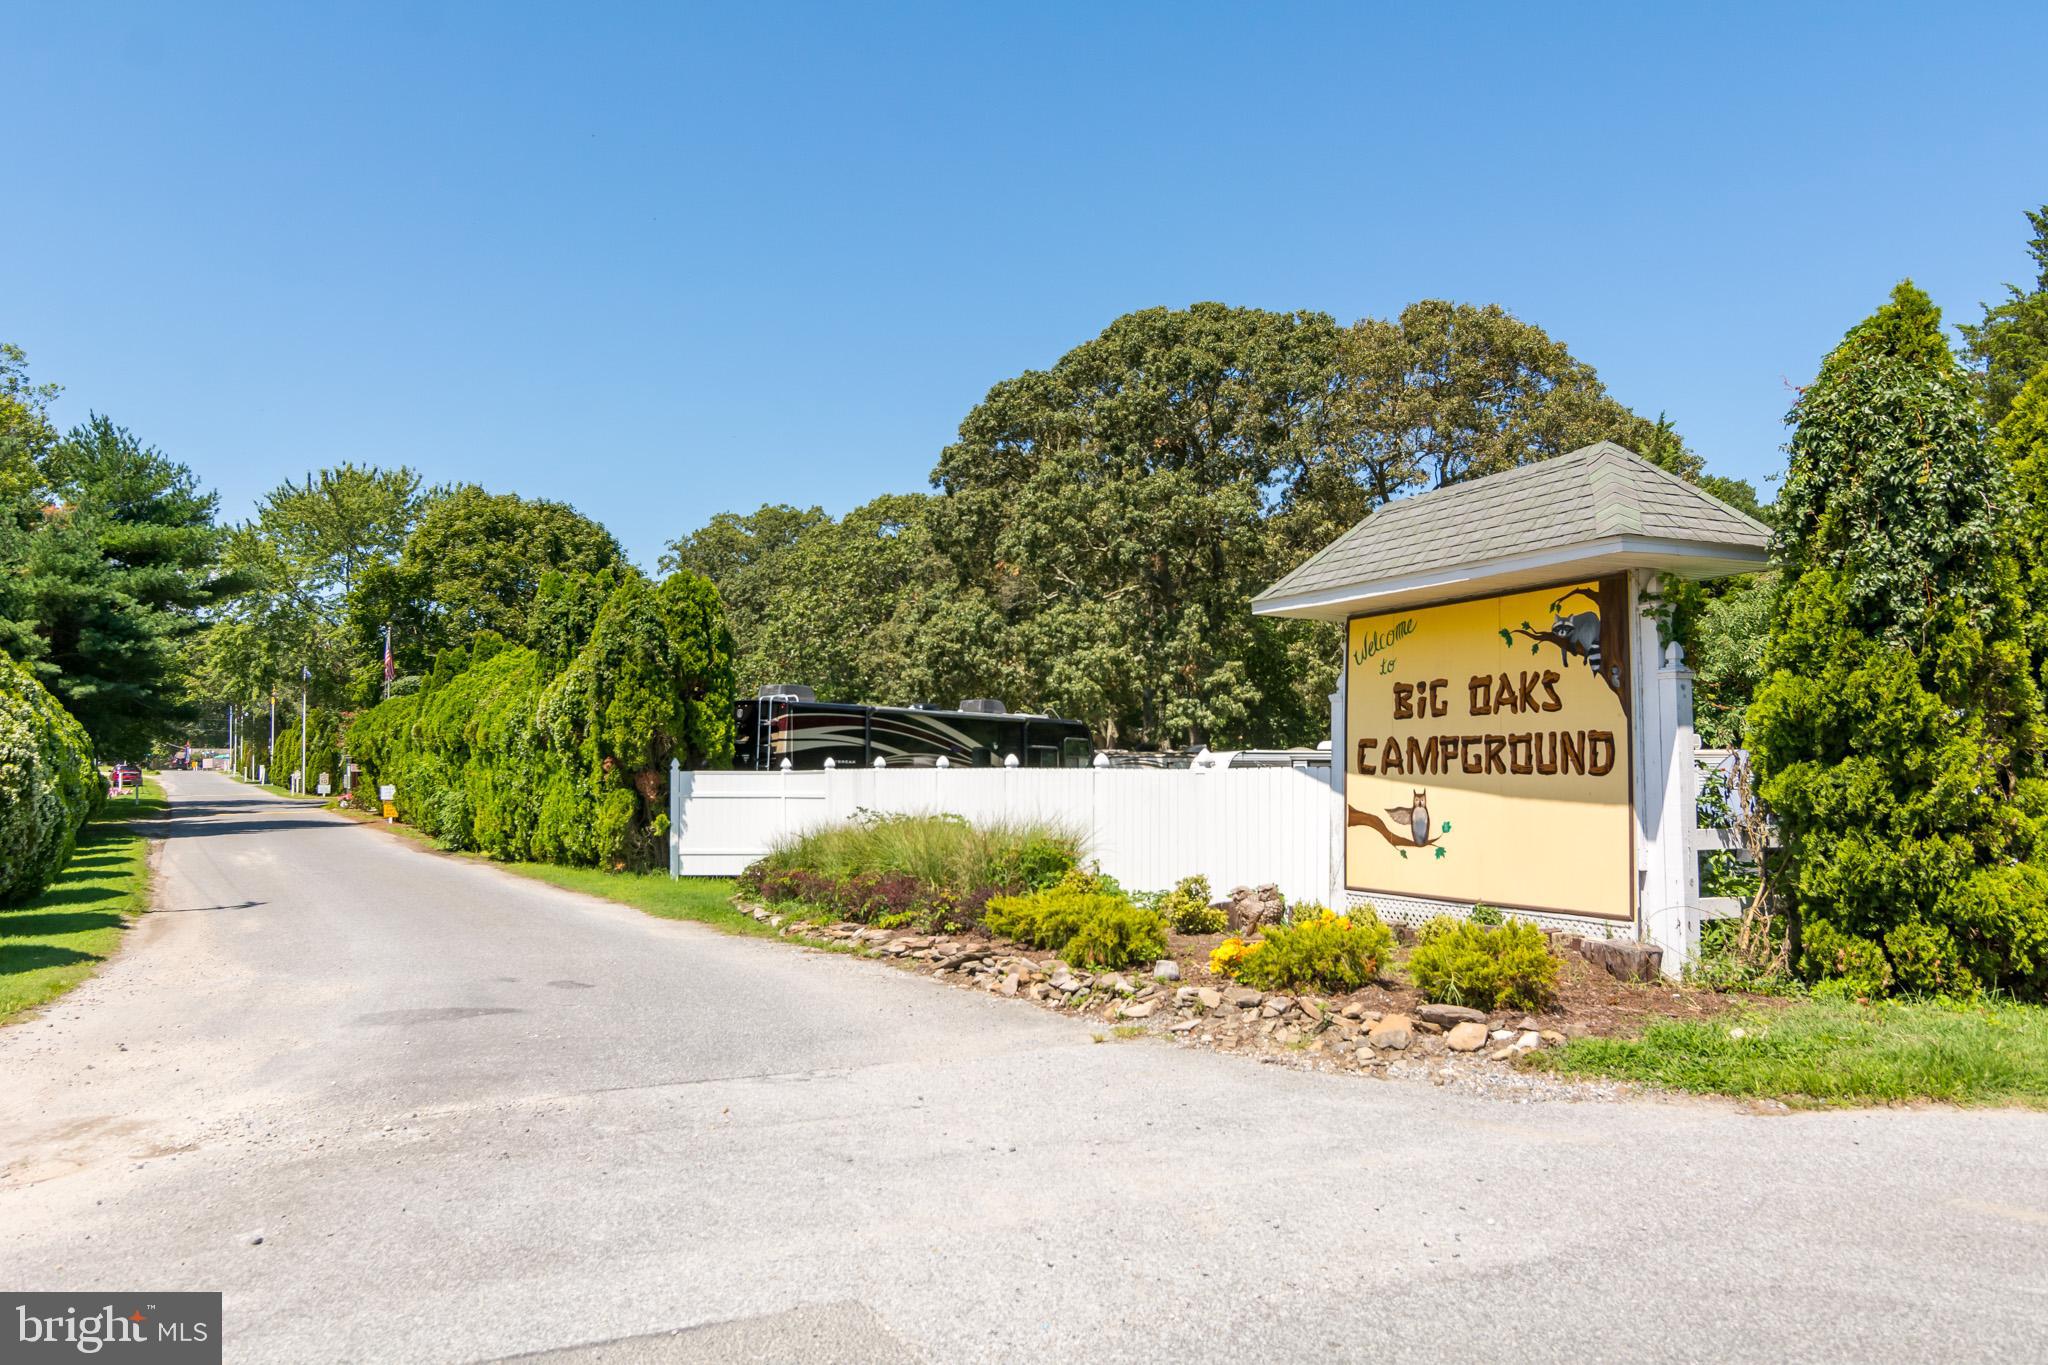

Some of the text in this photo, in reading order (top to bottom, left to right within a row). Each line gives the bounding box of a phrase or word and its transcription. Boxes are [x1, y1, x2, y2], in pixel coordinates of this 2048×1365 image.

[1354, 618, 1418, 666] Welcome
[1379, 657, 1397, 675] to
[1469, 670, 1562, 717] OAKS
[1357, 730, 1616, 776] CAMPGROUND
